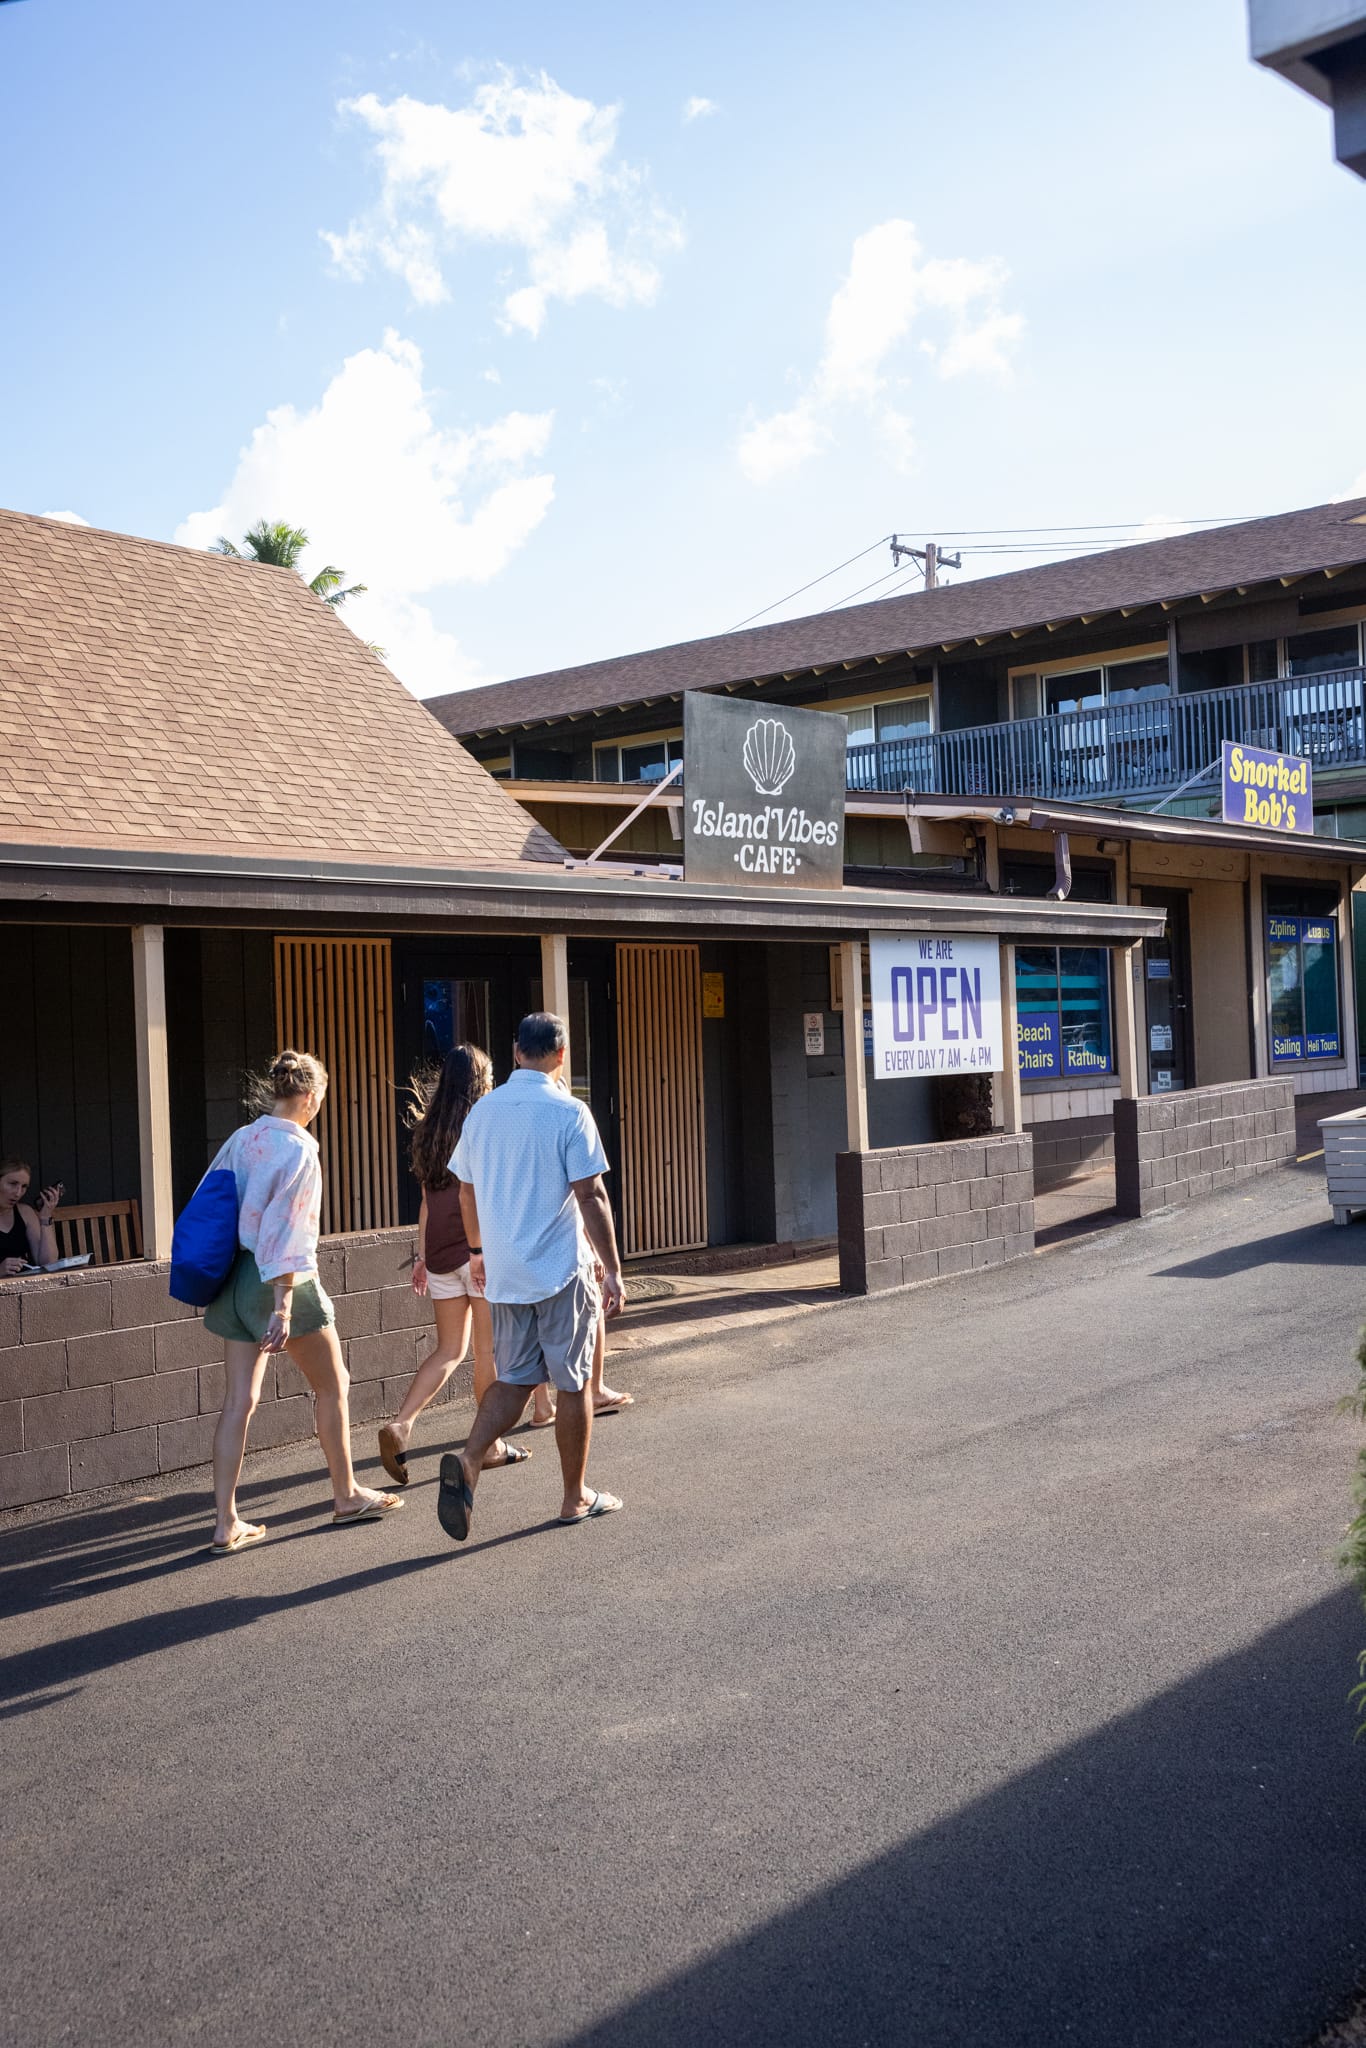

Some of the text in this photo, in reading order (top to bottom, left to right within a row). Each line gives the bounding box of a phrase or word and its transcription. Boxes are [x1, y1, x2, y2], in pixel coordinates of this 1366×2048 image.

[1229, 747, 1308, 796] Snorkel
[1243, 788, 1296, 830] Bob's
[692, 799, 838, 846] Island Vibes
[1269, 920, 1297, 939] Zipline
[1307, 923, 1330, 939] Luaus
[918, 939, 953, 960] WE ARE
[890, 966, 983, 1042] OPEN
[1016, 1022, 1051, 1042] Beach
[1274, 1039, 1301, 1057] Sailing
[1307, 1038, 1337, 1053] Heli Tours
[885, 1050, 915, 1072] EVERY
[918, 1049, 936, 1070] DAY
[939, 1048, 945, 1069] 7
[947, 1048, 961, 1068] AM
[970, 1048, 976, 1066] 4
[978, 1047, 992, 1066] PM
[1017, 1049, 1054, 1070] Chairs
